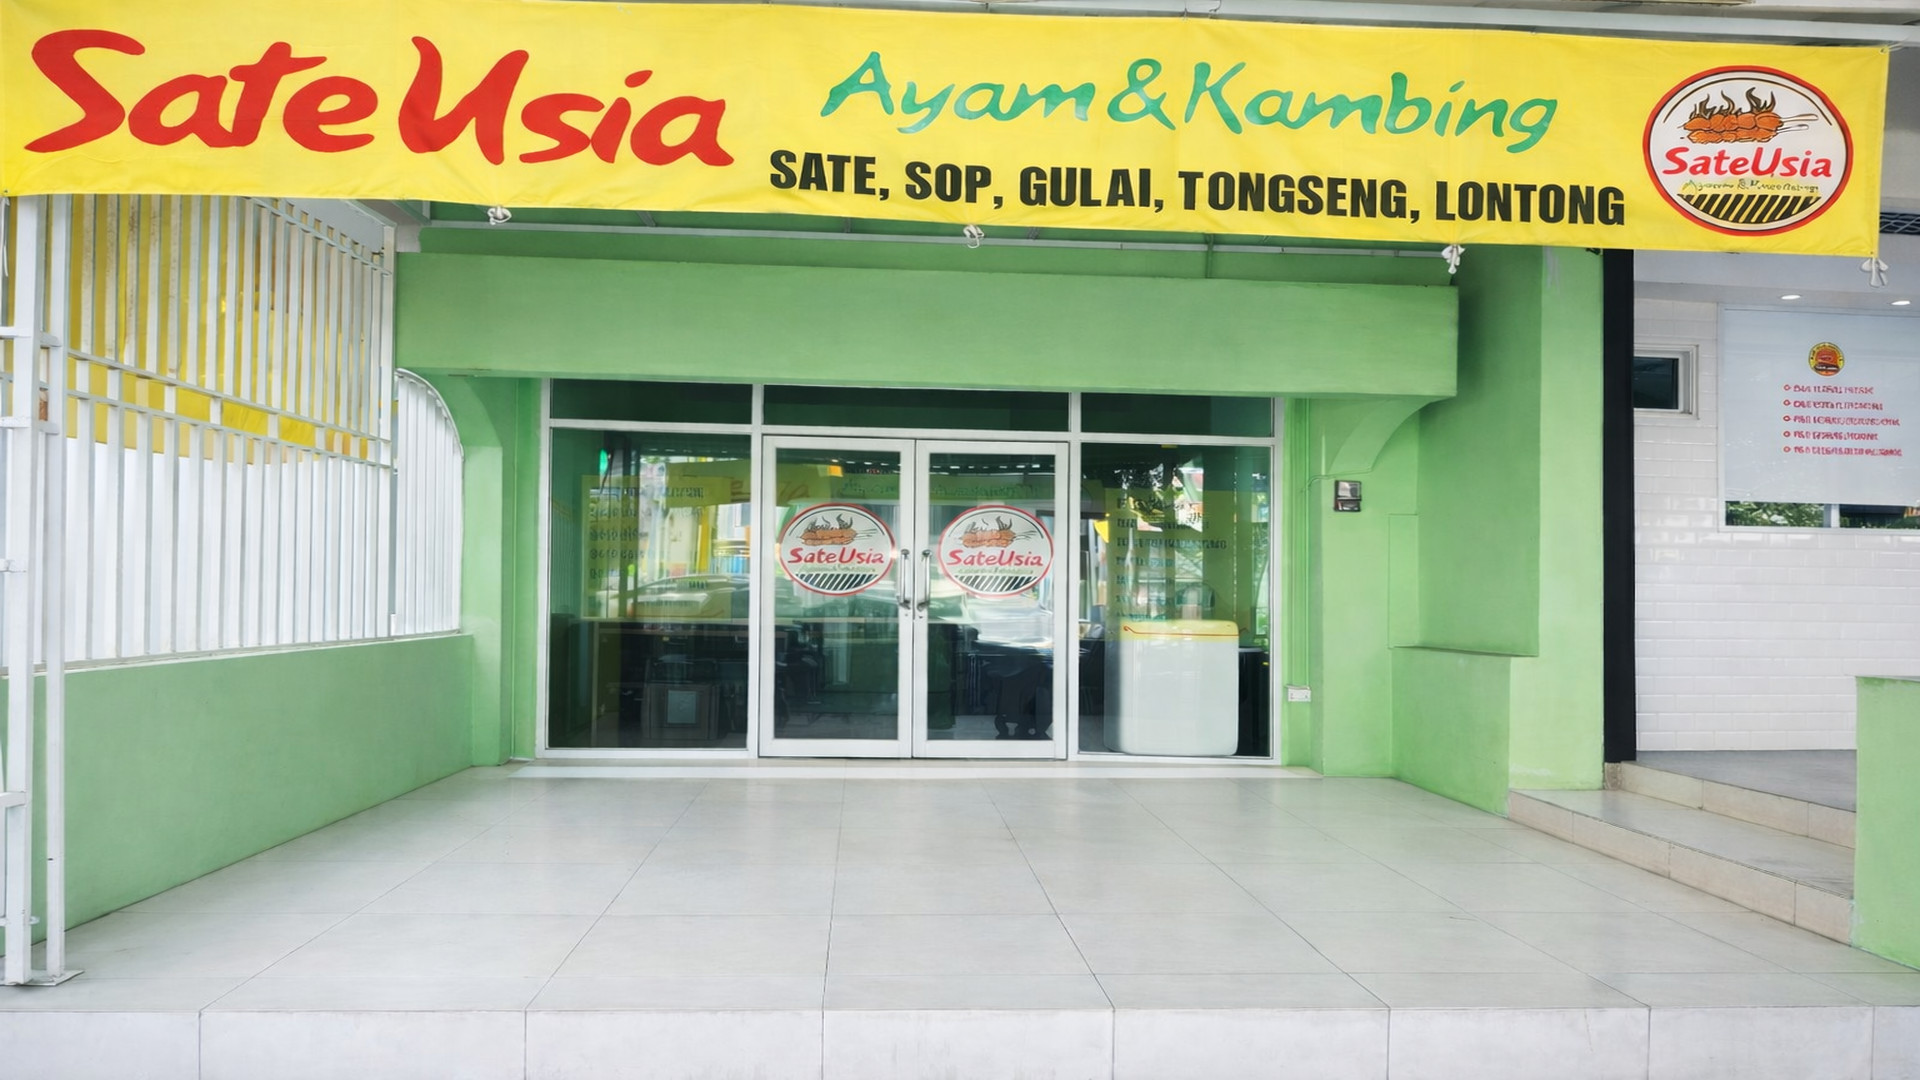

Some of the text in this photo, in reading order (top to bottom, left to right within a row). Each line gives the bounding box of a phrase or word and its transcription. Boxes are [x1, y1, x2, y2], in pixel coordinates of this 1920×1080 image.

[820, 51, 1558, 153] Ayam & Kambing
[769, 149, 1626, 227] SATE, SOP, GULAI, TONGSENG, LONTONG
